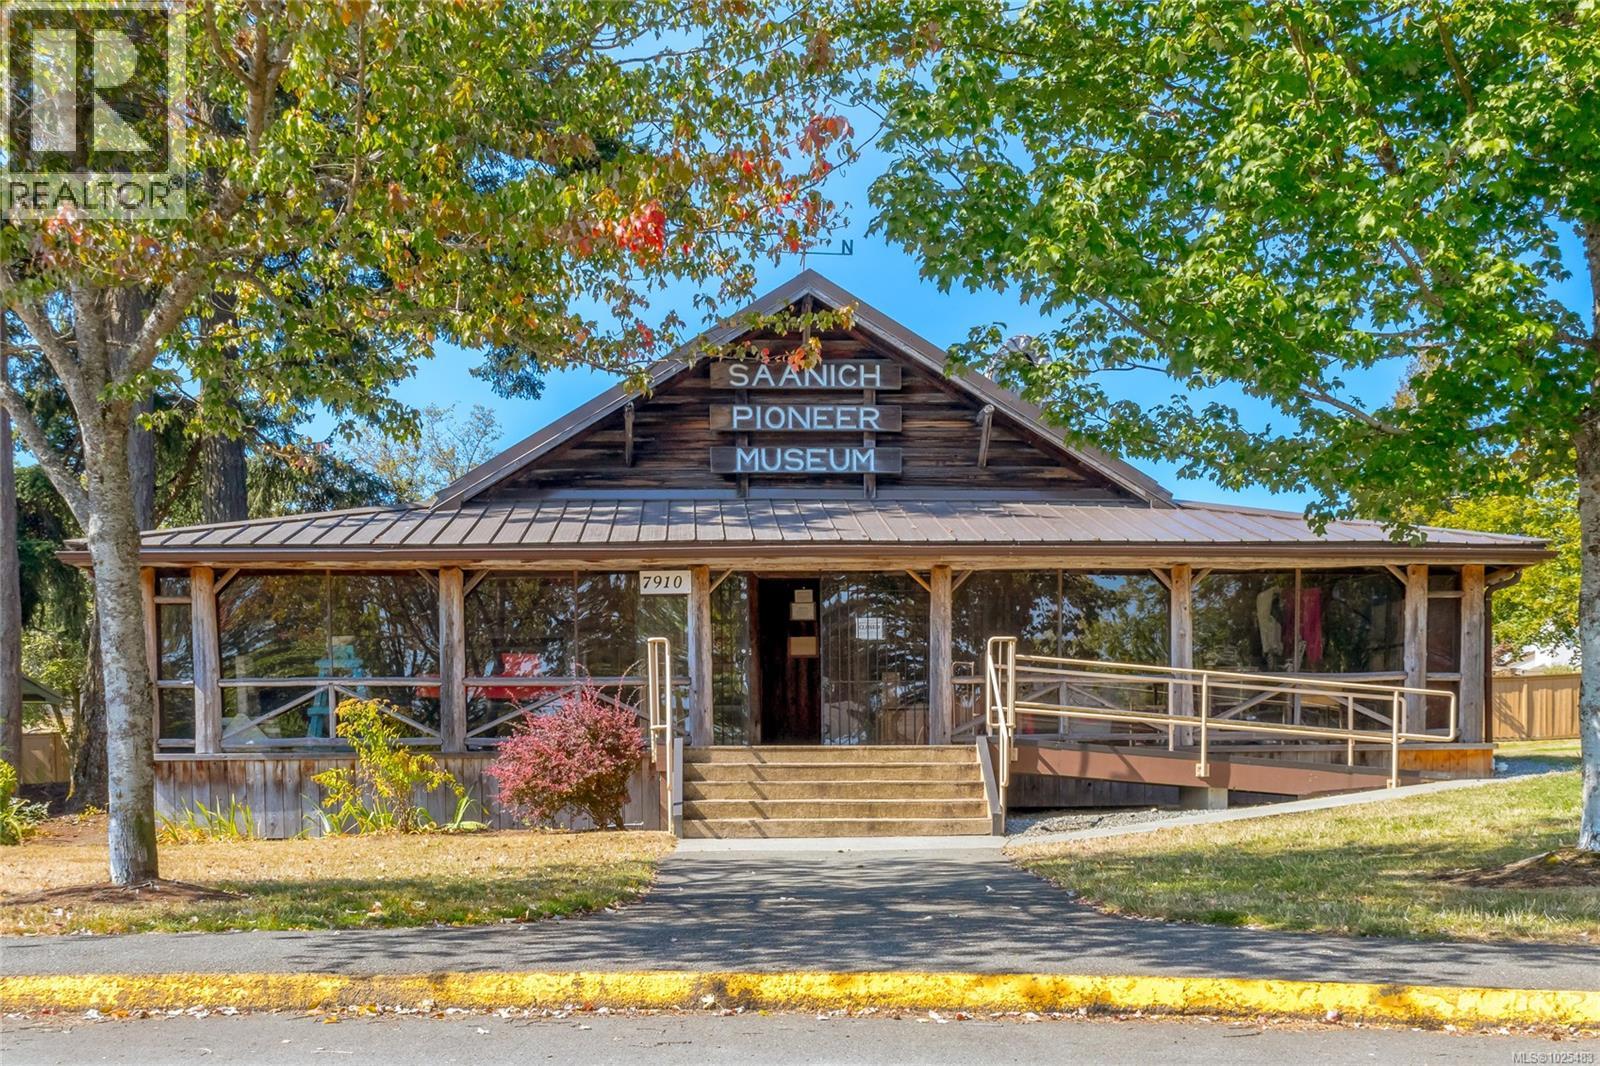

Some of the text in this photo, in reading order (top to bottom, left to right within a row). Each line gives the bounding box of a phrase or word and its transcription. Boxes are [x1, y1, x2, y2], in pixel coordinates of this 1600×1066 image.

[842, 239, 853, 255] N
[728, 363, 881, 387] SAANICH
[732, 406, 880, 430] PIONEER
[736, 448, 876, 472] MUSEUM
[643, 575, 683, 589] 7910
